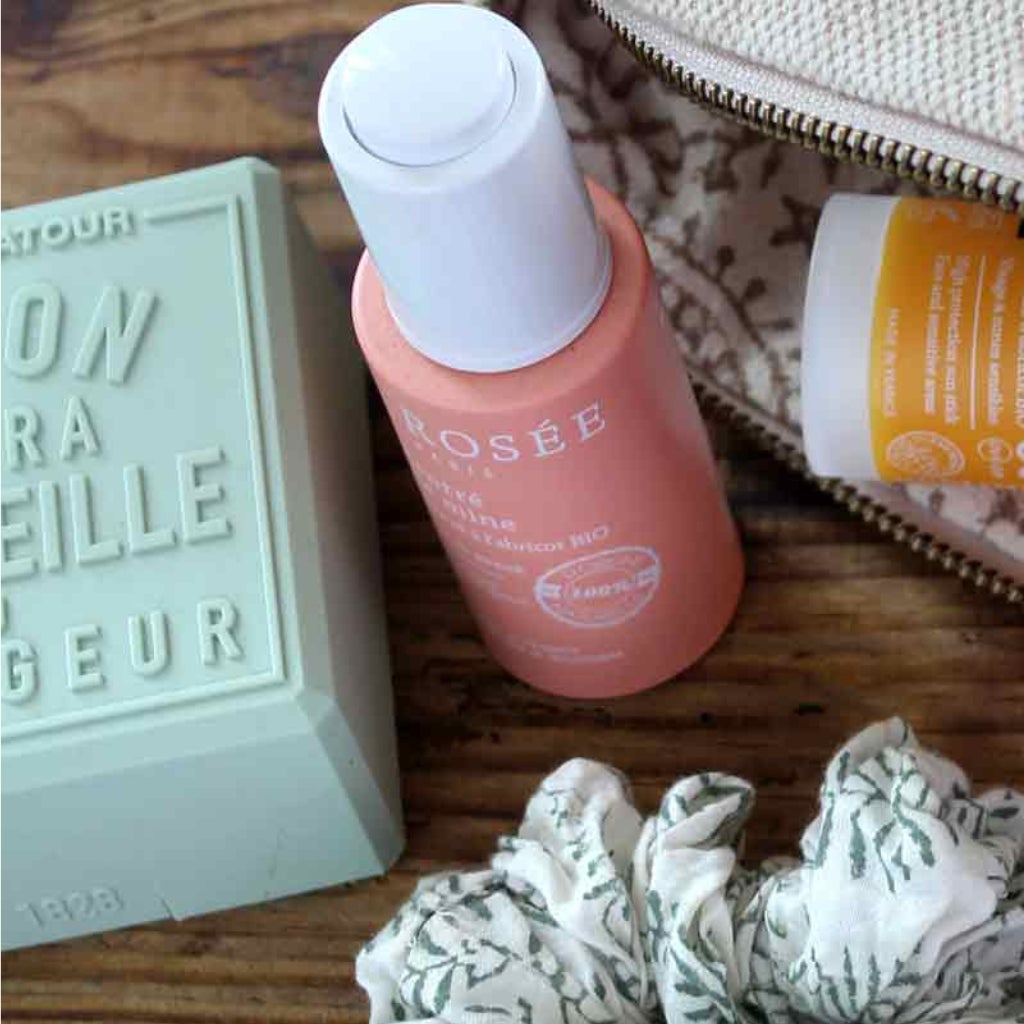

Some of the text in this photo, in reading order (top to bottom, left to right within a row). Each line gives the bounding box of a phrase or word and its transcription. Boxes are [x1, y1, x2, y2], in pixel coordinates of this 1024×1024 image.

[929, 284, 946, 310] and
[944, 288, 964, 363] protection
[402, 402, 606, 463] ROSÉE
